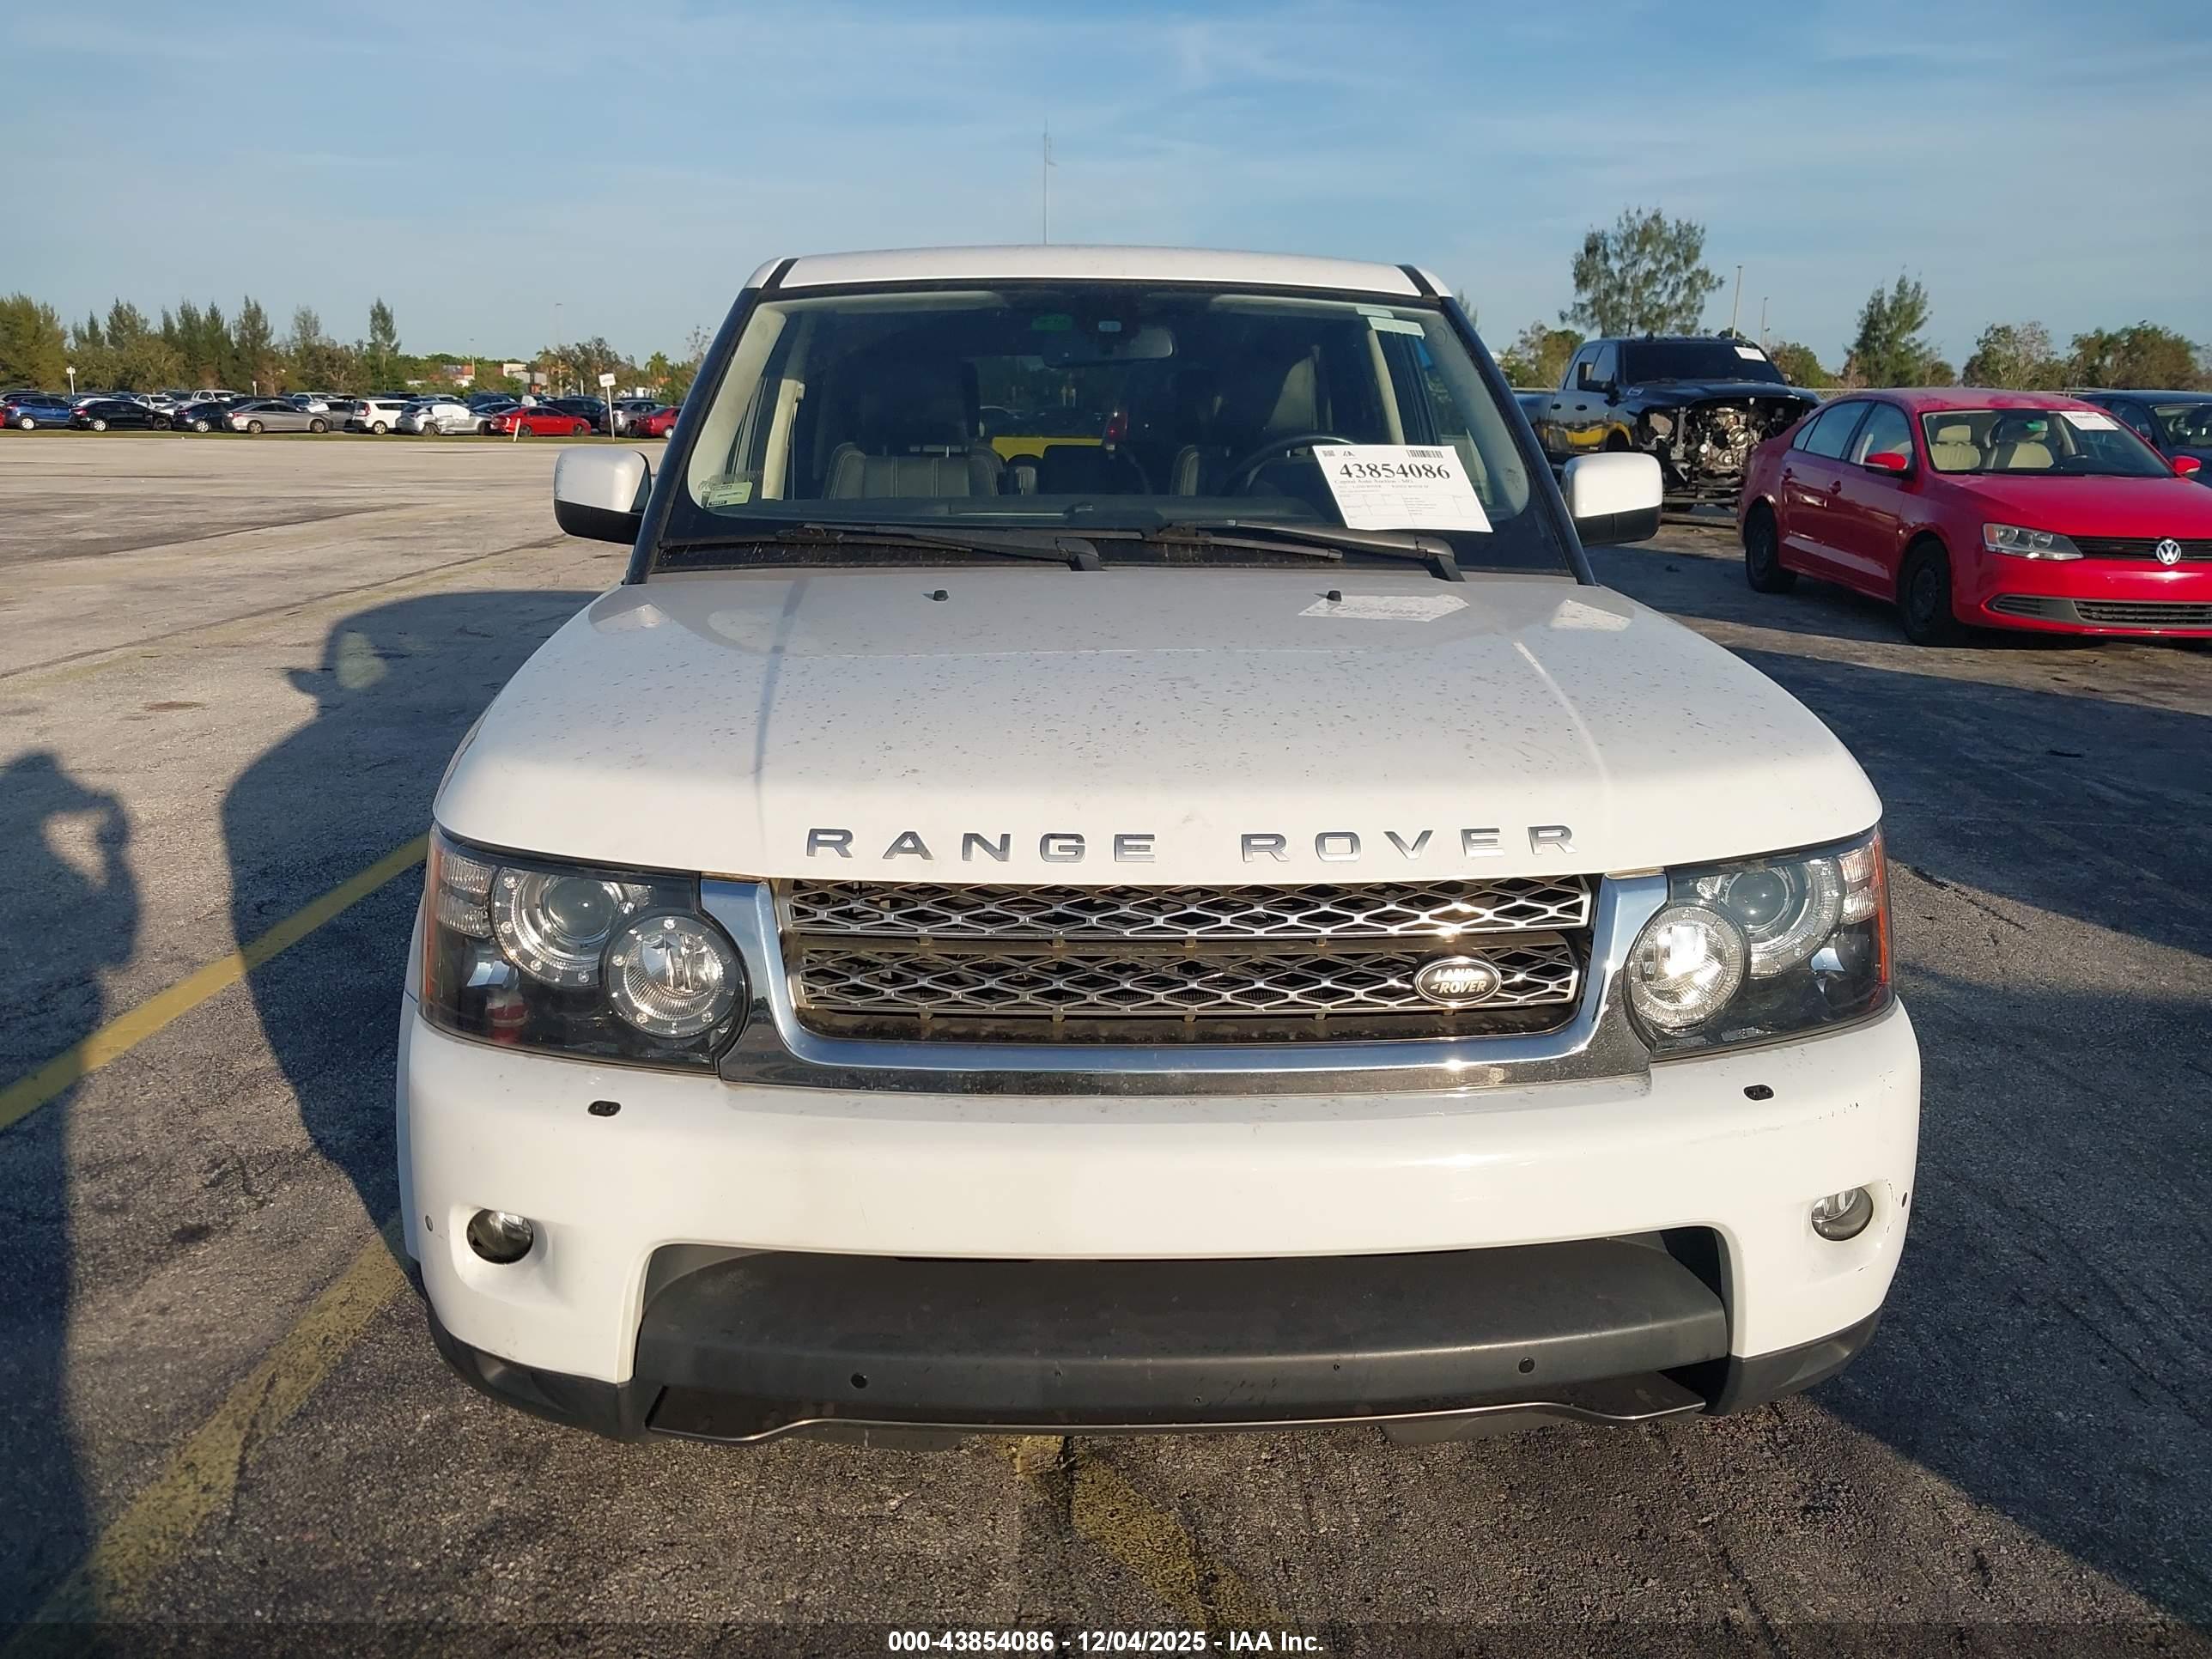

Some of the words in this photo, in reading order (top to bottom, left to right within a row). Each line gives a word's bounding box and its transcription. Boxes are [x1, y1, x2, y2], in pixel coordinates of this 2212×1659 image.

[1340, 463, 1450, 479] 43854086
[805, 827, 1158, 863] RANGE
[1240, 823, 1579, 863] ROVER
[1437, 980, 1487, 994] ROVER
